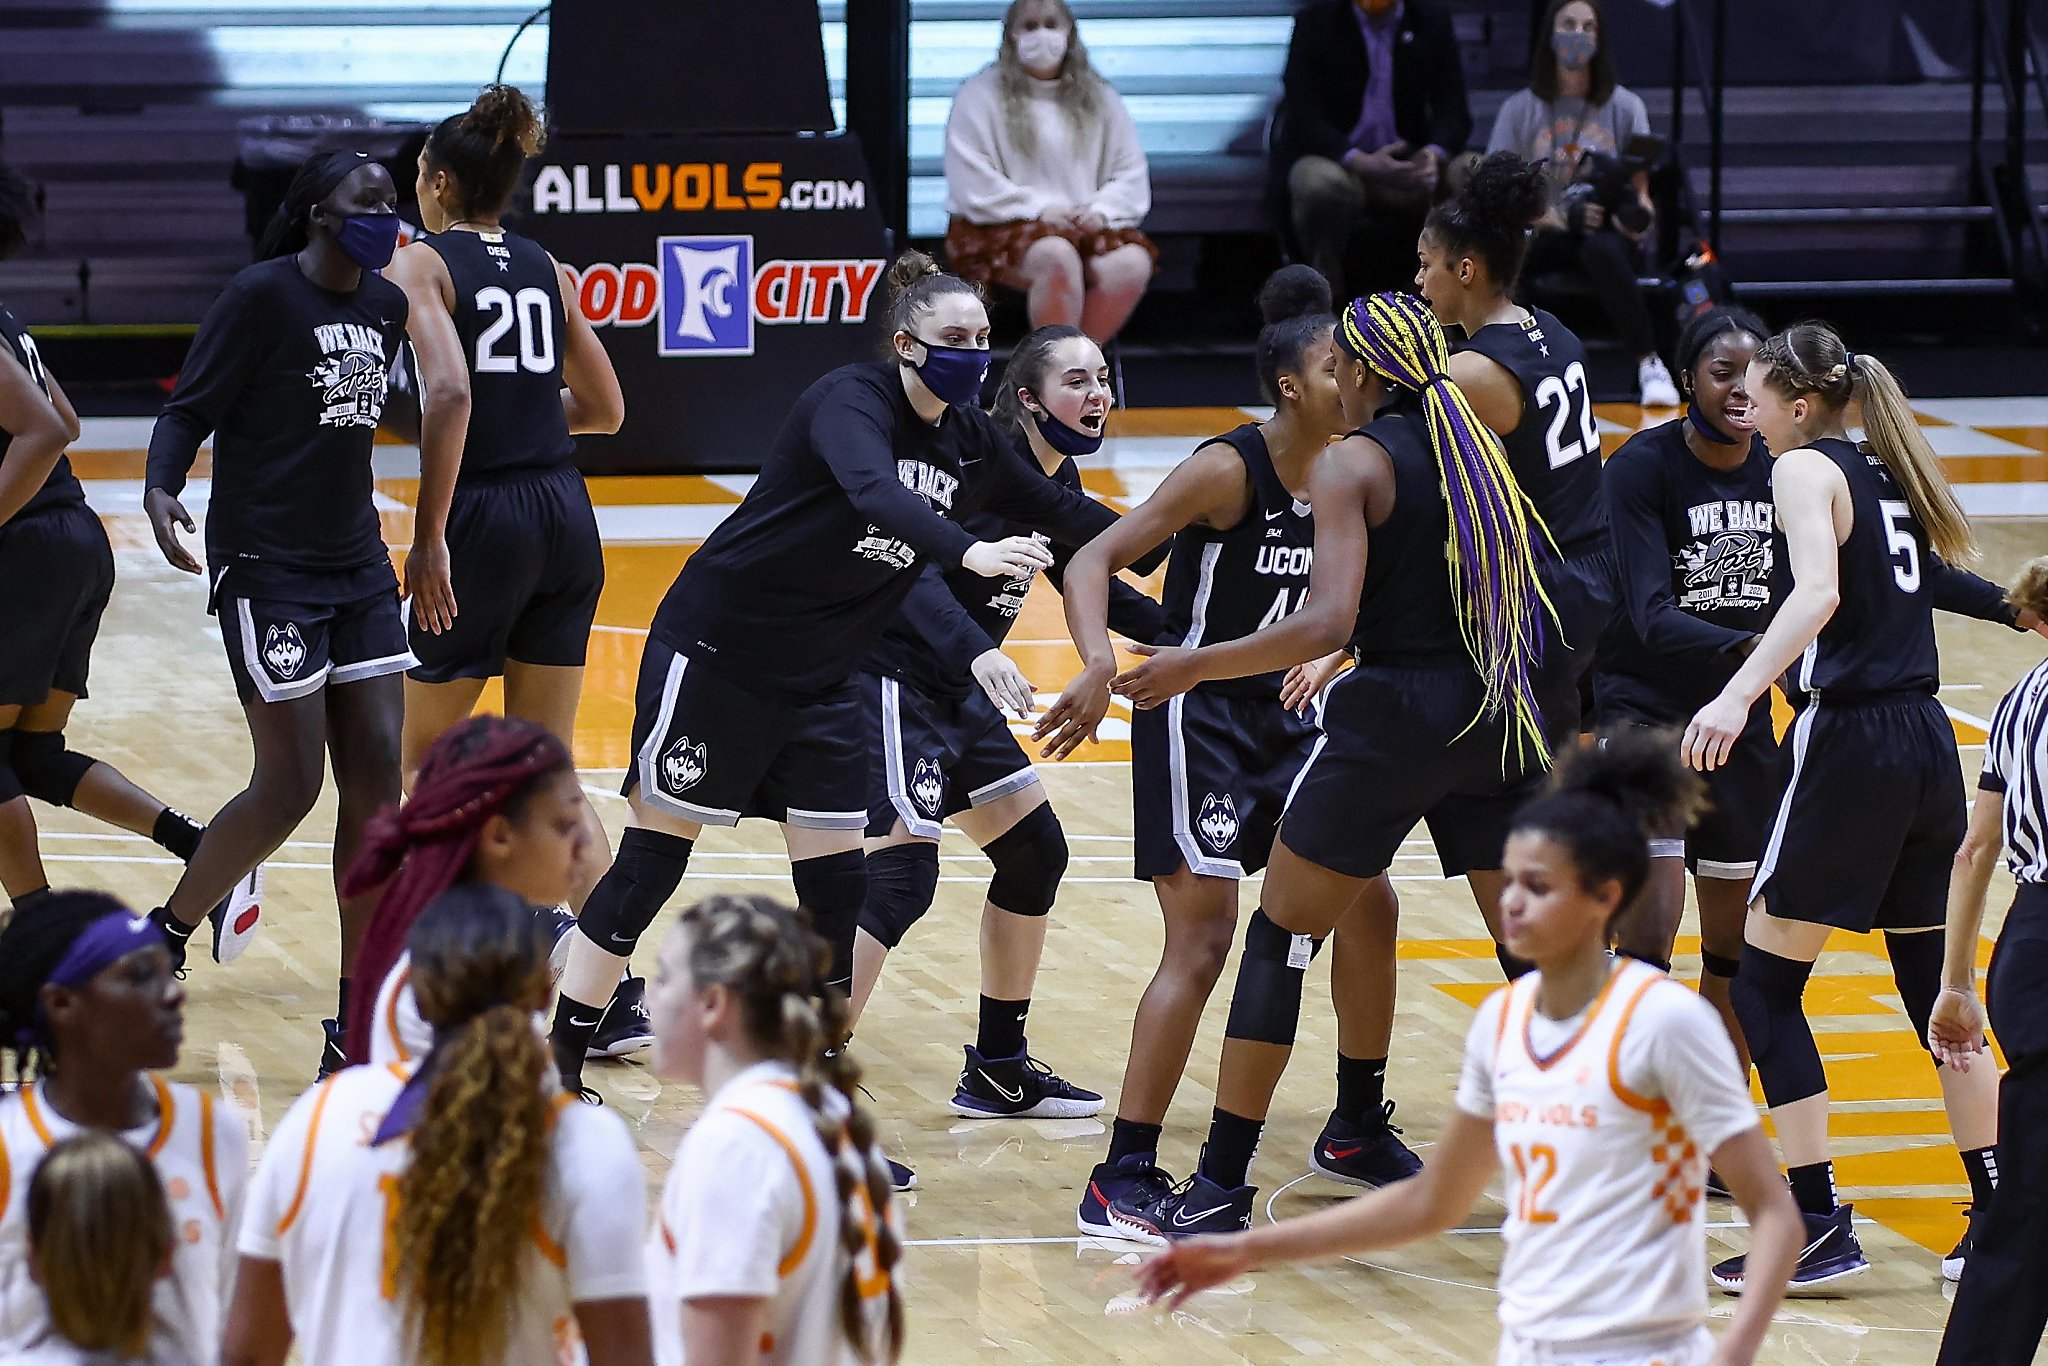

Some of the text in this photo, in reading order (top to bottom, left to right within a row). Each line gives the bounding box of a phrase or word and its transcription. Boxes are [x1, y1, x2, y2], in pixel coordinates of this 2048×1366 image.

[533, 162, 866, 213] ALLVOLS.COM
[564, 264, 660, 327] OD
[752, 260, 887, 325] CITY
[314, 323, 349, 354] WE
[475, 286, 556, 373] 20
[1527, 329, 1545, 342] DEE
[1535, 361, 1600, 470] 22
[918, 461, 959, 510] BACK
[1688, 501, 1723, 537] WE
[1254, 545, 1313, 576] UCON
[1684, 531, 1764, 587] Pat
[1879, 499, 1921, 593] 5
[1699, 590, 1713, 599] 2011
[1509, 1144, 1560, 1224] 12
